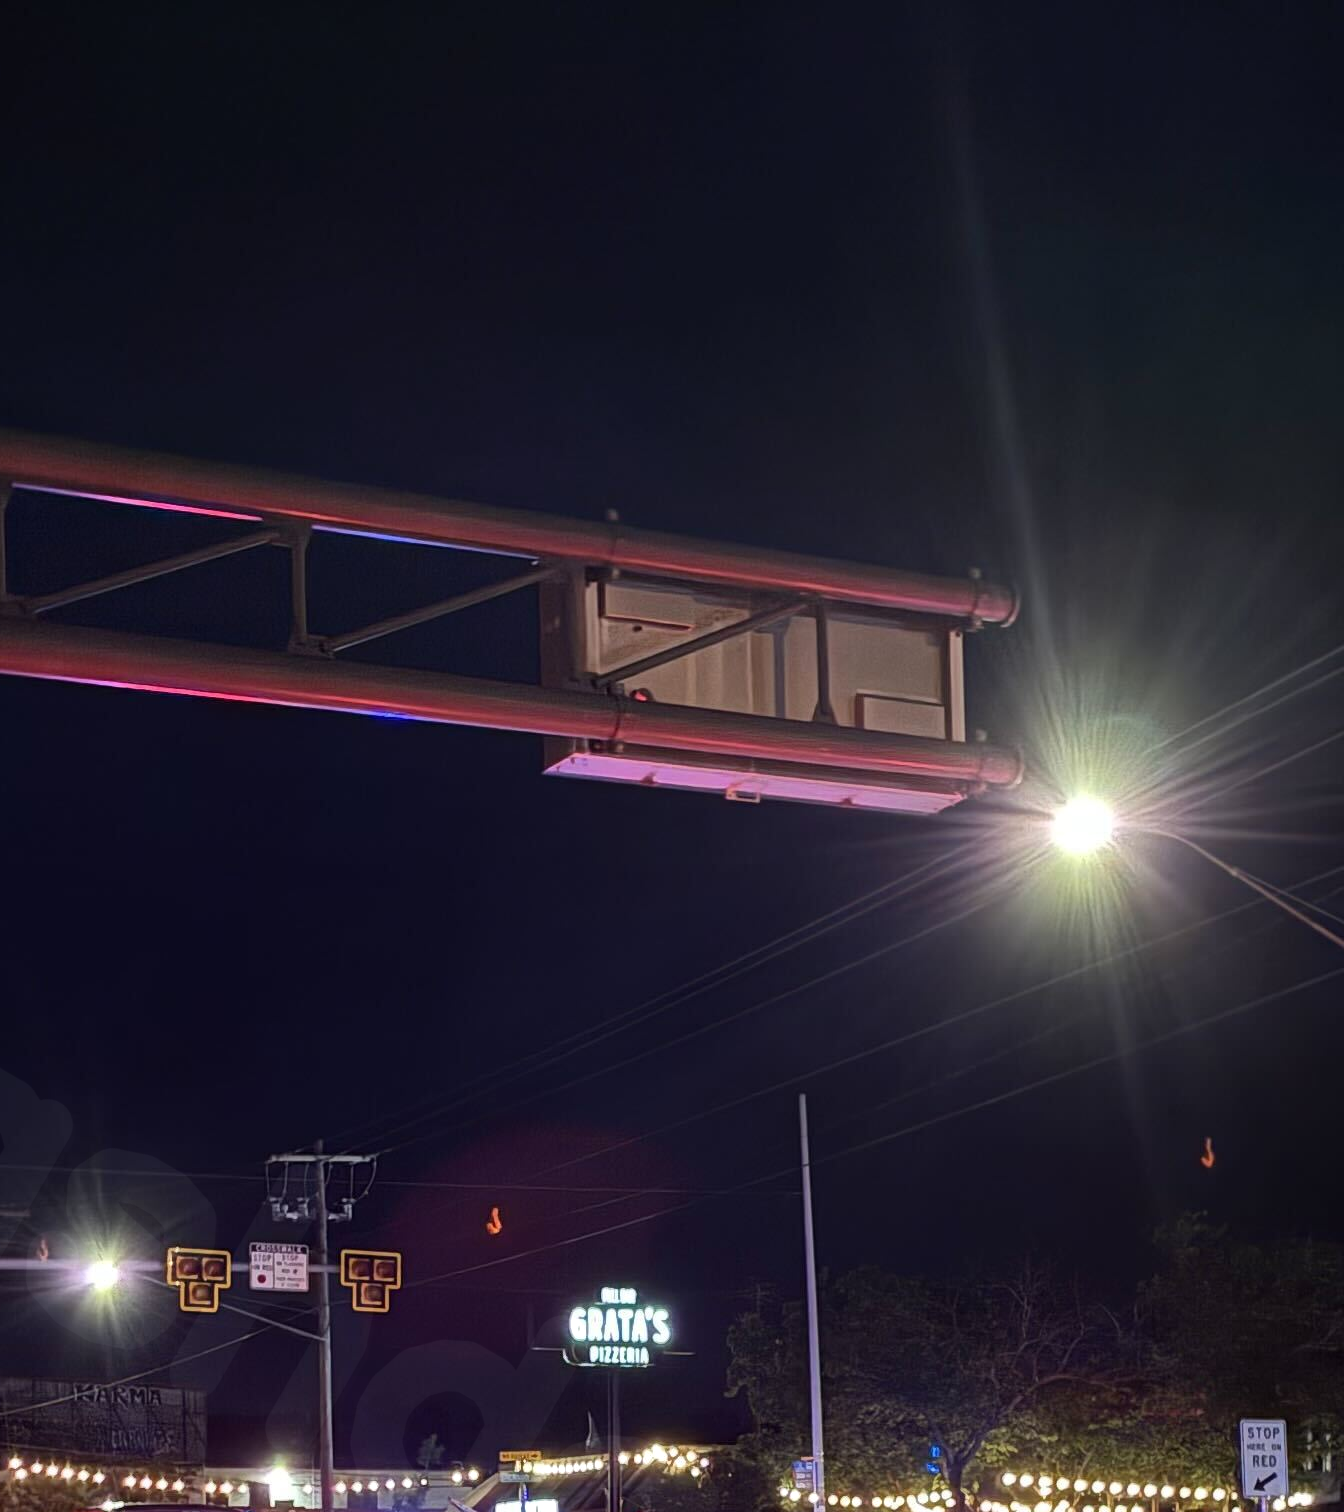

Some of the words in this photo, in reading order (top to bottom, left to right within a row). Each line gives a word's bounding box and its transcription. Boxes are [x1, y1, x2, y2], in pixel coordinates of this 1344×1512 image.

[569, 1305, 671, 1345] GRATA'S
[589, 1345, 650, 1364] PIZZERIA
[73, 1382, 162, 1409] KARMA
[1247, 1427, 1280, 1440] STOP
[1246, 1443, 1266, 1451] HERE
[1271, 1443, 1282, 1451] ON
[1252, 1454, 1277, 1468] RED
